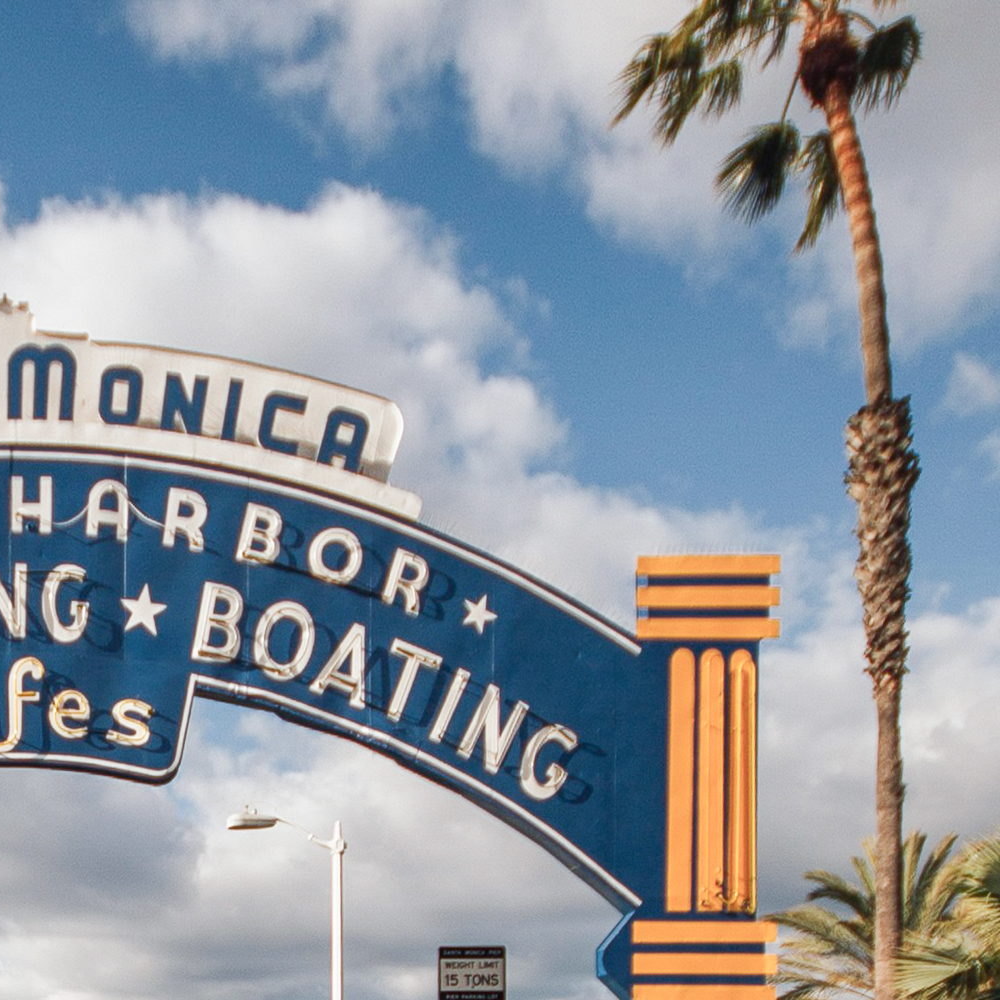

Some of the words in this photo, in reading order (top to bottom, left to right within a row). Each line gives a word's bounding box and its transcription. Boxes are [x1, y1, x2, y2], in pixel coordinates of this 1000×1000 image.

[7, 343, 370, 475] MONICA
[10, 475, 430, 616] HARBOR
[191, 581, 579, 800] BOATING
[444, 961, 475, 970] WEIGHT
[478, 961, 499, 970] LIMIT
[445, 974, 459, 987] 15
[464, 974, 499, 987] TONS
